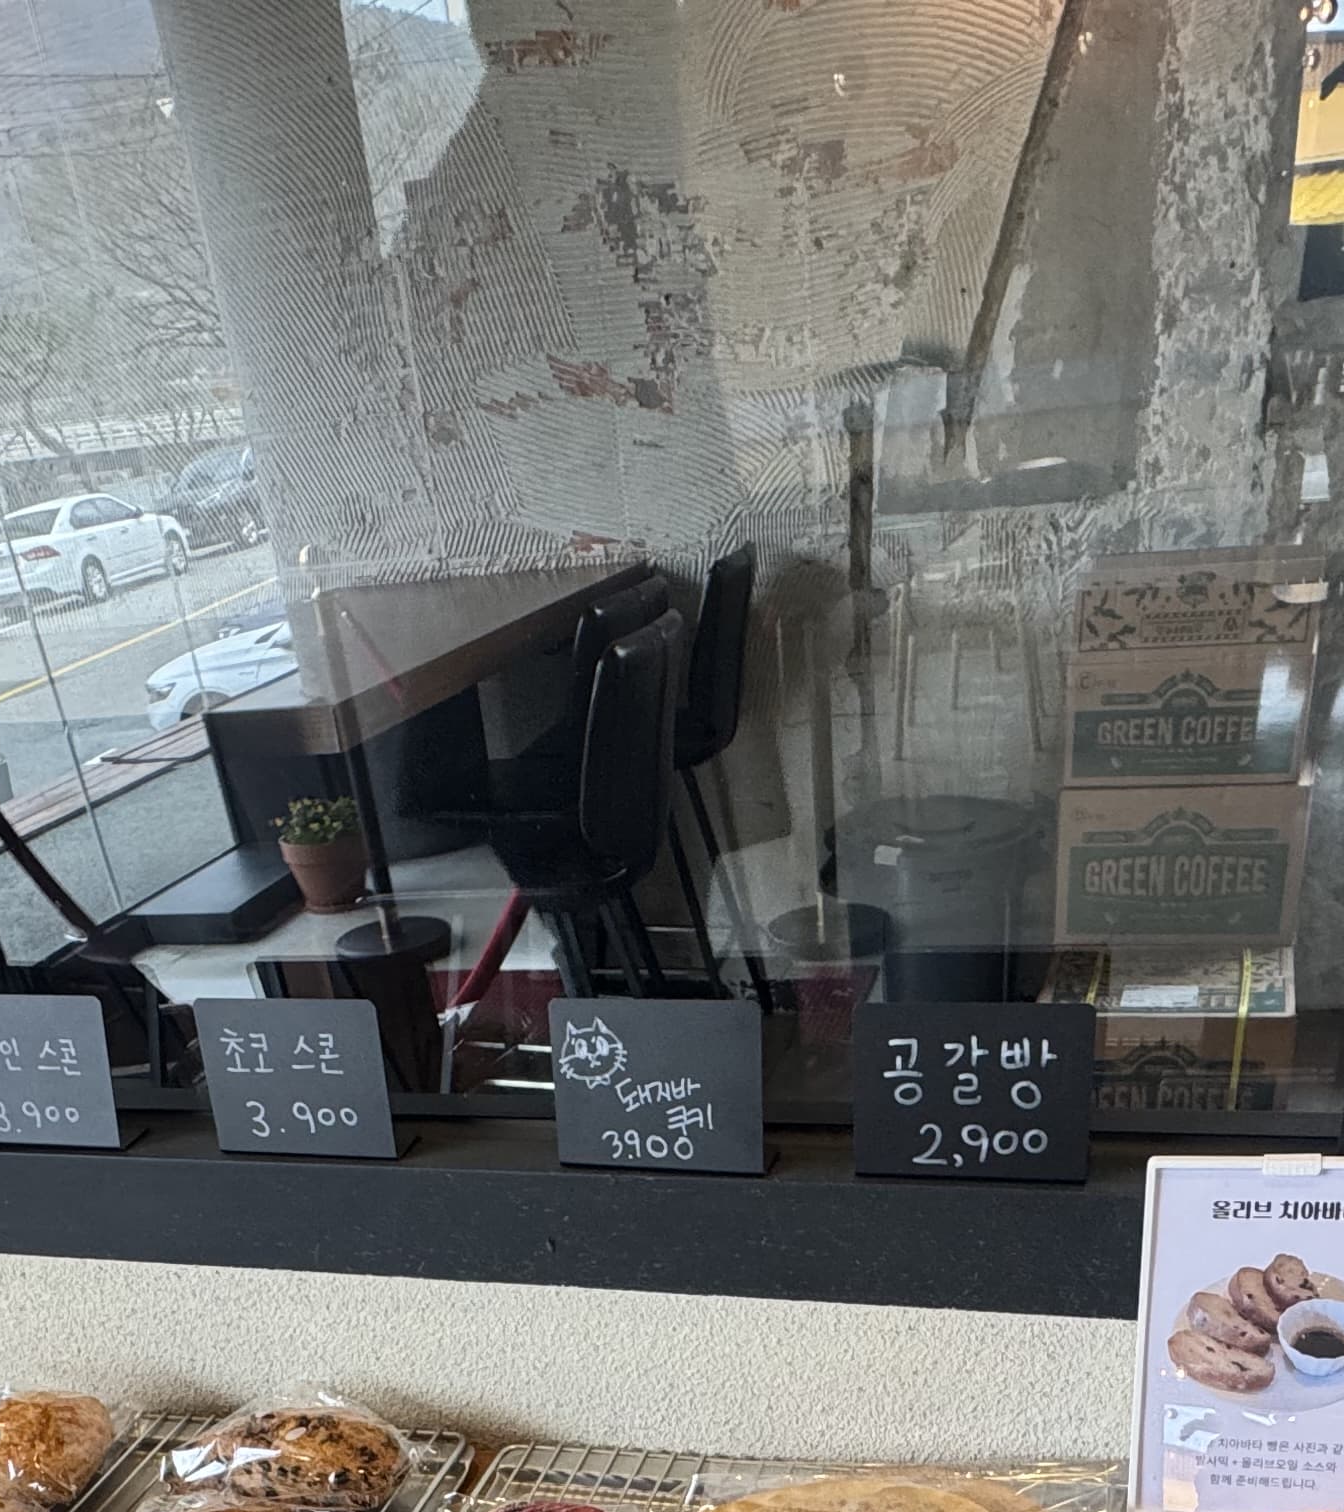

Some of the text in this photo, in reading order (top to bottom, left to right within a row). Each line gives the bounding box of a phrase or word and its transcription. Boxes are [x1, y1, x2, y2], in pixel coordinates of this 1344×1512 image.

[1098, 714, 1265, 745] GREEN COFFE
[1085, 855, 1267, 896] GREEN COFFEE
[37, 1038, 82, 1076] 스콘
[219, 1028, 344, 1075] 초코 스콘
[883, 1035, 1058, 1110] 공갈빵
[614, 1077, 702, 1113] 돼지바
[665, 1103, 714, 1136] 쿠키
[912, 1123, 1049, 1168] 2,900
[1212, 1200, 1273, 1219] 올리브
[1218, 1438, 1262, 1450] 치아바타
[1293, 1442, 1328, 1454] 사진과
